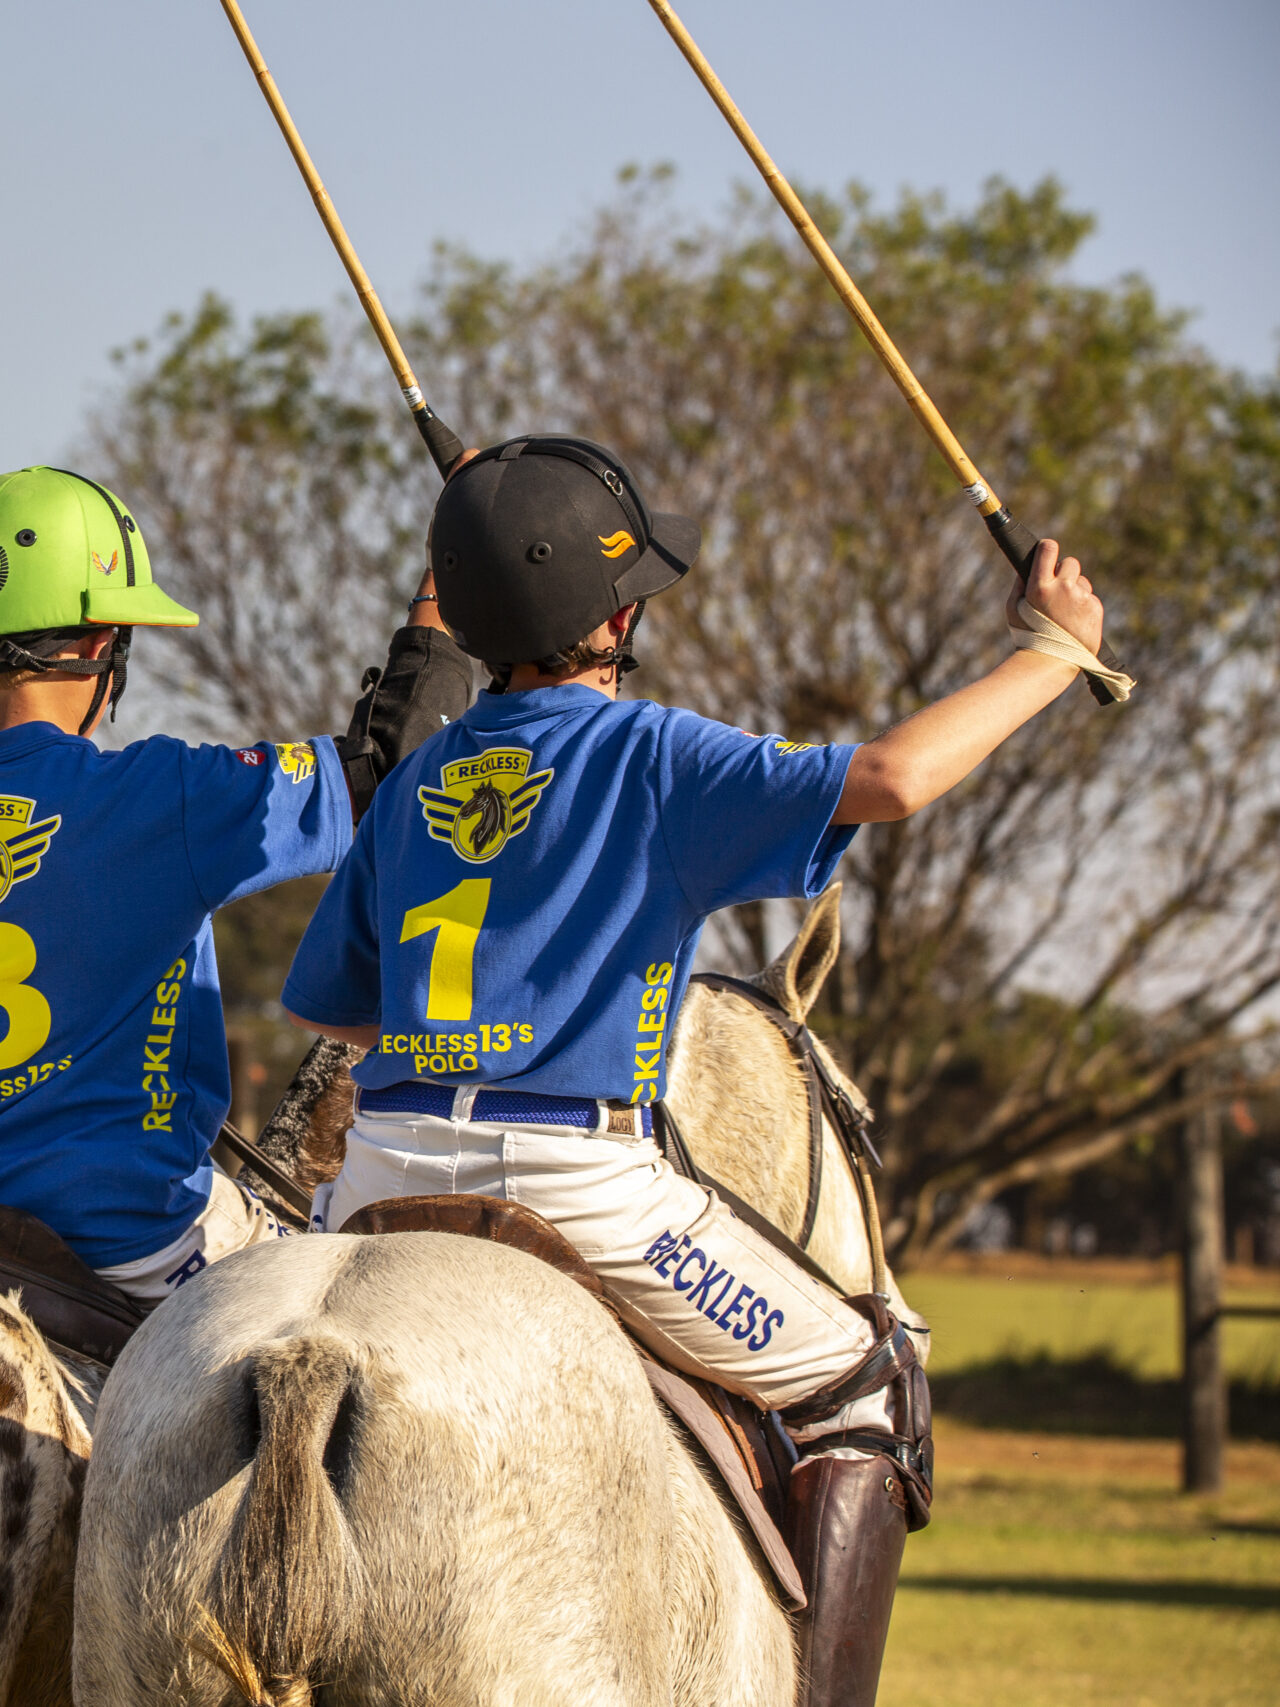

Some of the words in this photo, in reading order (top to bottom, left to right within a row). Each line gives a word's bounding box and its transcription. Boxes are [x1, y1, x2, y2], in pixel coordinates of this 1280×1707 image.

[459, 756, 520, 778] RECKLESS
[400, 878, 492, 1020] 1
[142, 957, 187, 1133] RECKLESS
[378, 1033, 478, 1054] ECKLESS
[414, 1053, 479, 1074] POLO
[630, 962, 673, 1104] CKLESS
[642, 1229, 785, 1352] RECKLESS
